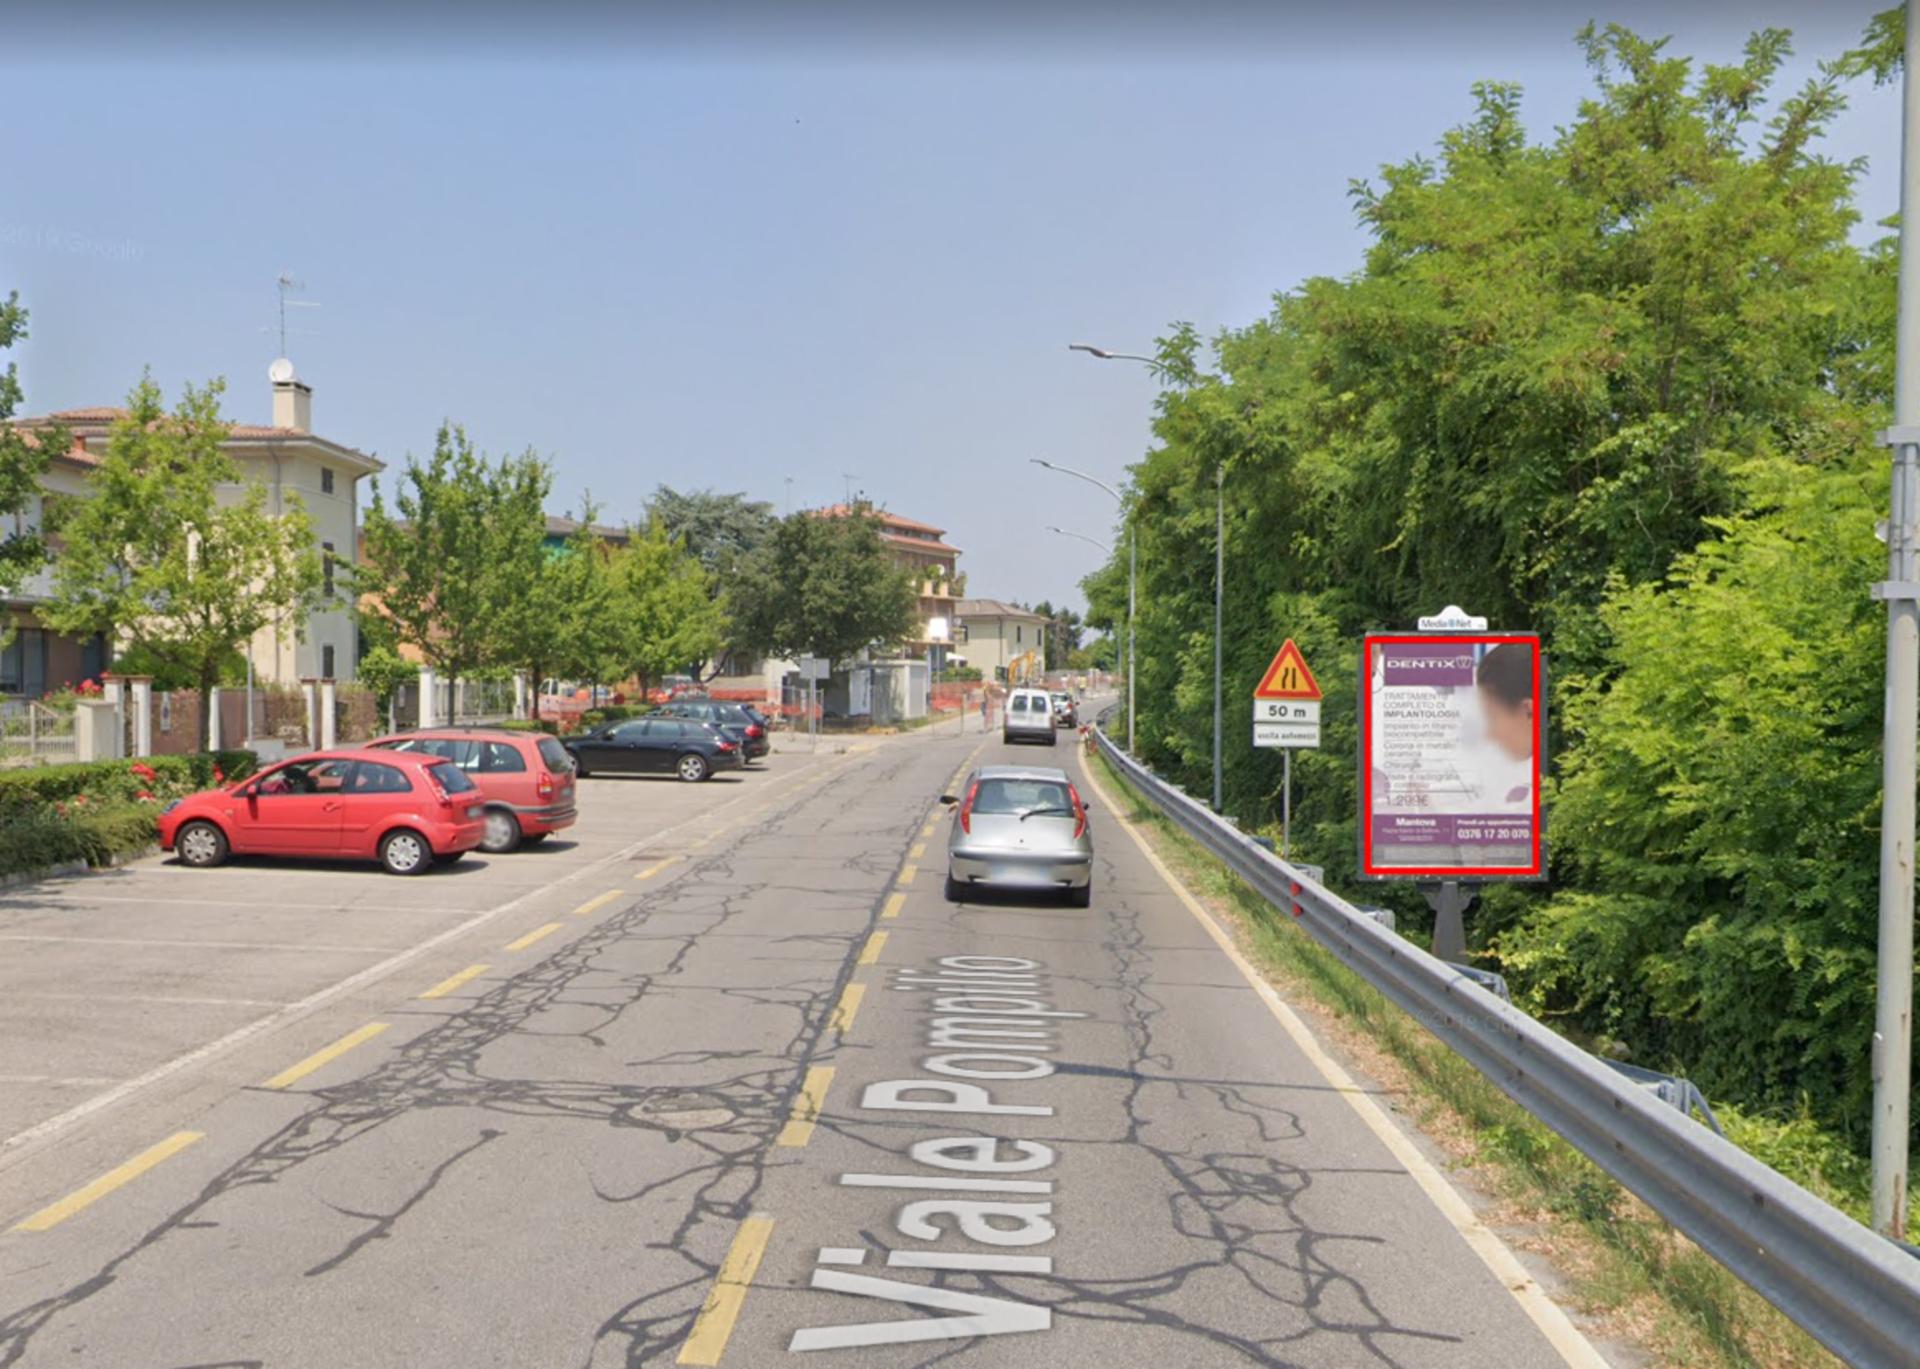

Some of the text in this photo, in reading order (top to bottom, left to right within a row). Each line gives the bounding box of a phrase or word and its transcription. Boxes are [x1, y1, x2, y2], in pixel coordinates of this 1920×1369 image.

[1386, 659, 1456, 669] DENTIX
[1383, 701, 1434, 709] COMPLETO
[1269, 705, 1306, 717] 50 m
[1484, 828, 1496, 840] 17
[1497, 828, 1510, 840] 20
